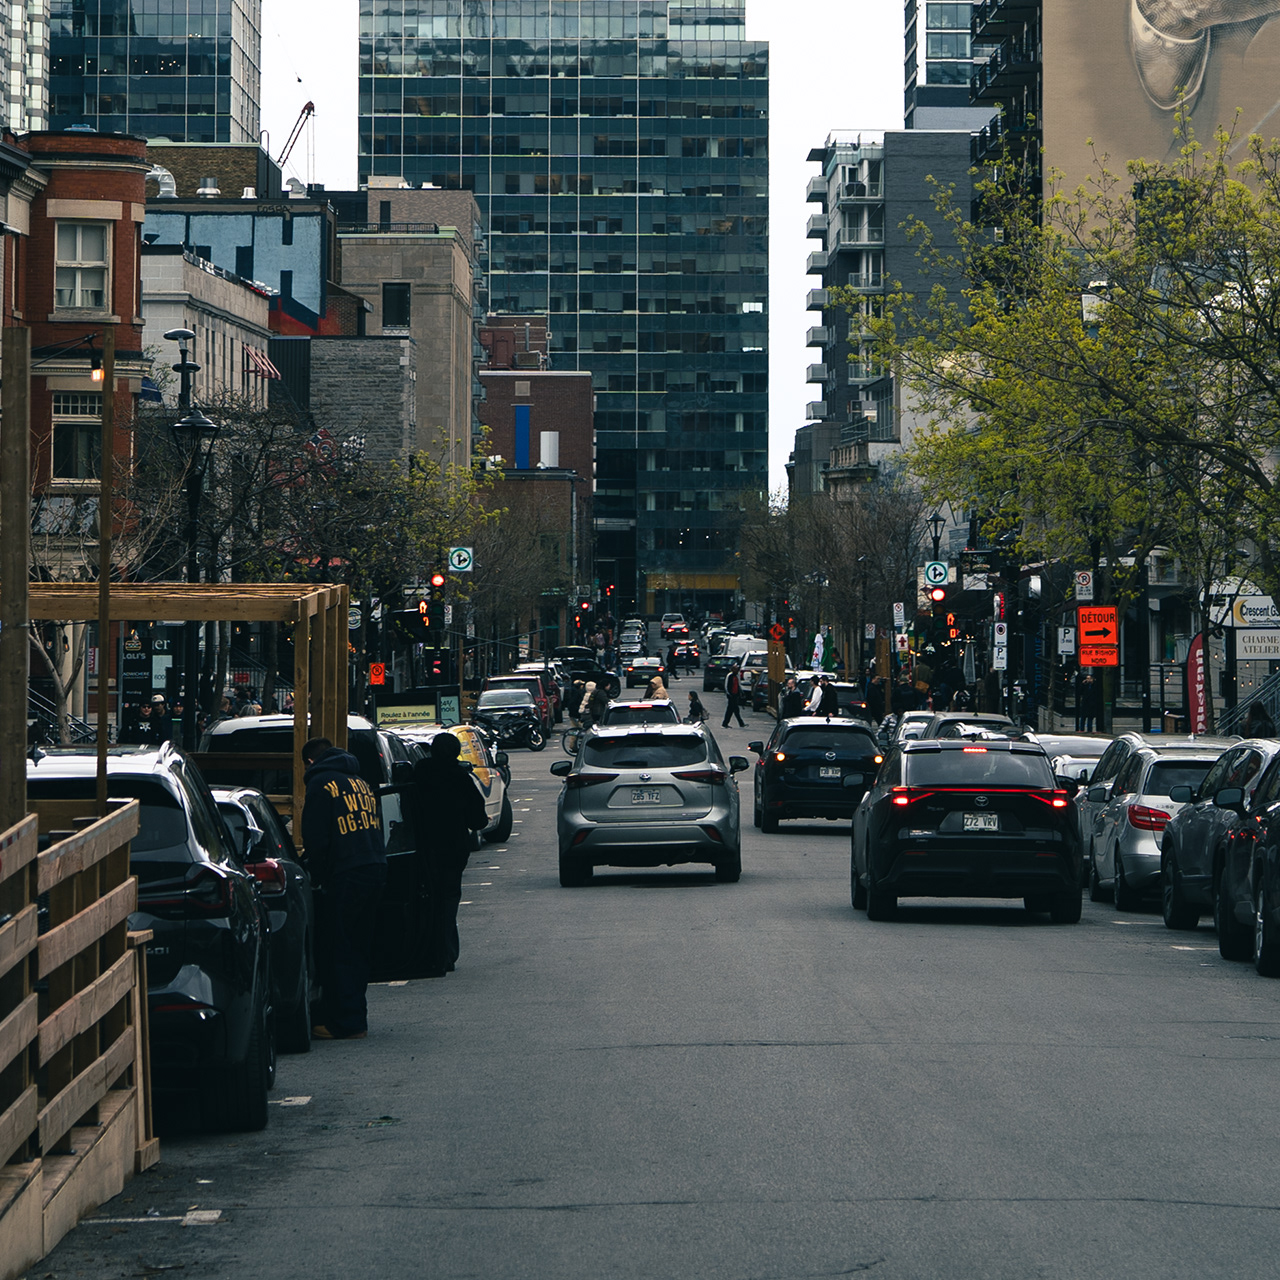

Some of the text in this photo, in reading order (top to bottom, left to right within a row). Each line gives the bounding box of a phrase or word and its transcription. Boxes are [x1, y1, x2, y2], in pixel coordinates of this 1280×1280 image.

[1242, 604, 1269, 616] Crescent
[1081, 612, 1116, 623] DÉTOUR
[1242, 636, 1280, 644] CHARME
[982, 817, 997, 827] VRV
